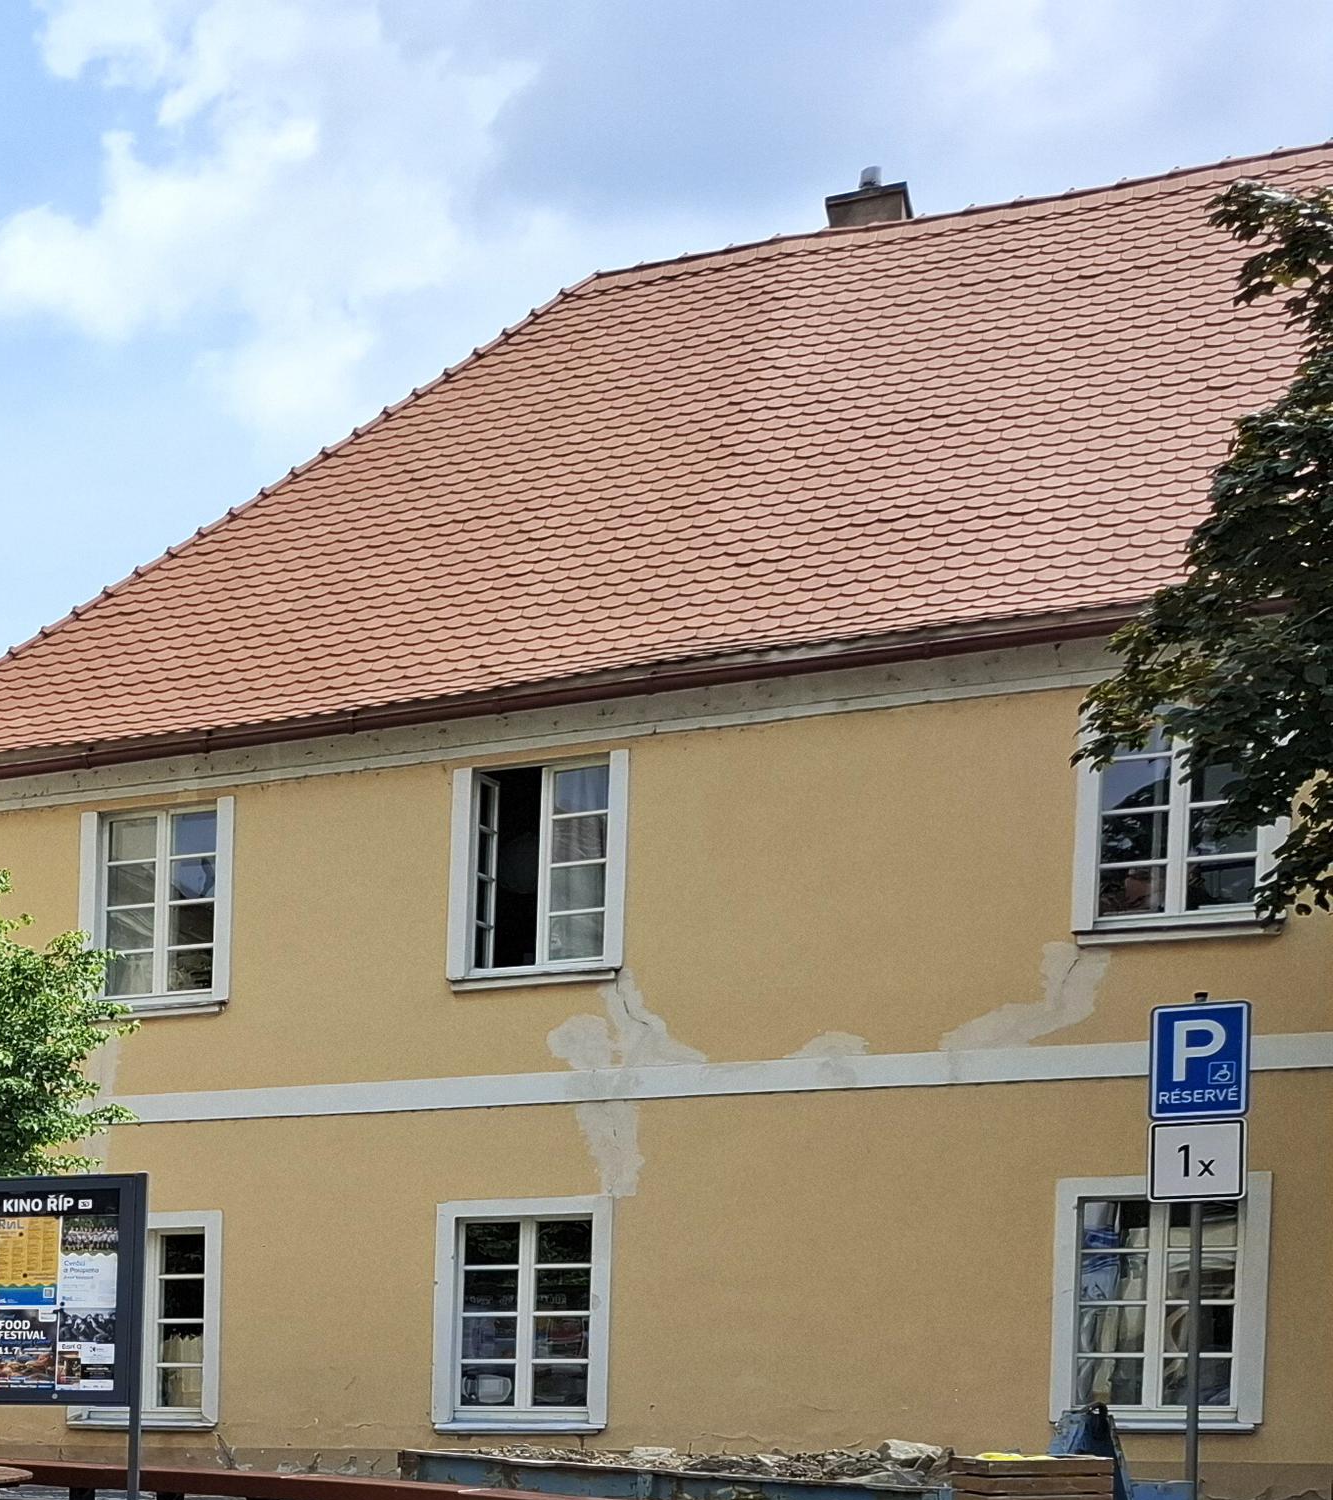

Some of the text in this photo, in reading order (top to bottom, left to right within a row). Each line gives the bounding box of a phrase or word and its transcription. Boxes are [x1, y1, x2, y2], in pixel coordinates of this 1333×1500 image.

[1172, 1019, 1227, 1082] P
[1158, 1085, 1239, 1105] RÉSERVÉ
[3, 1198, 43, 1212] KINO
[47, 1194, 74, 1212] ŘÍP
